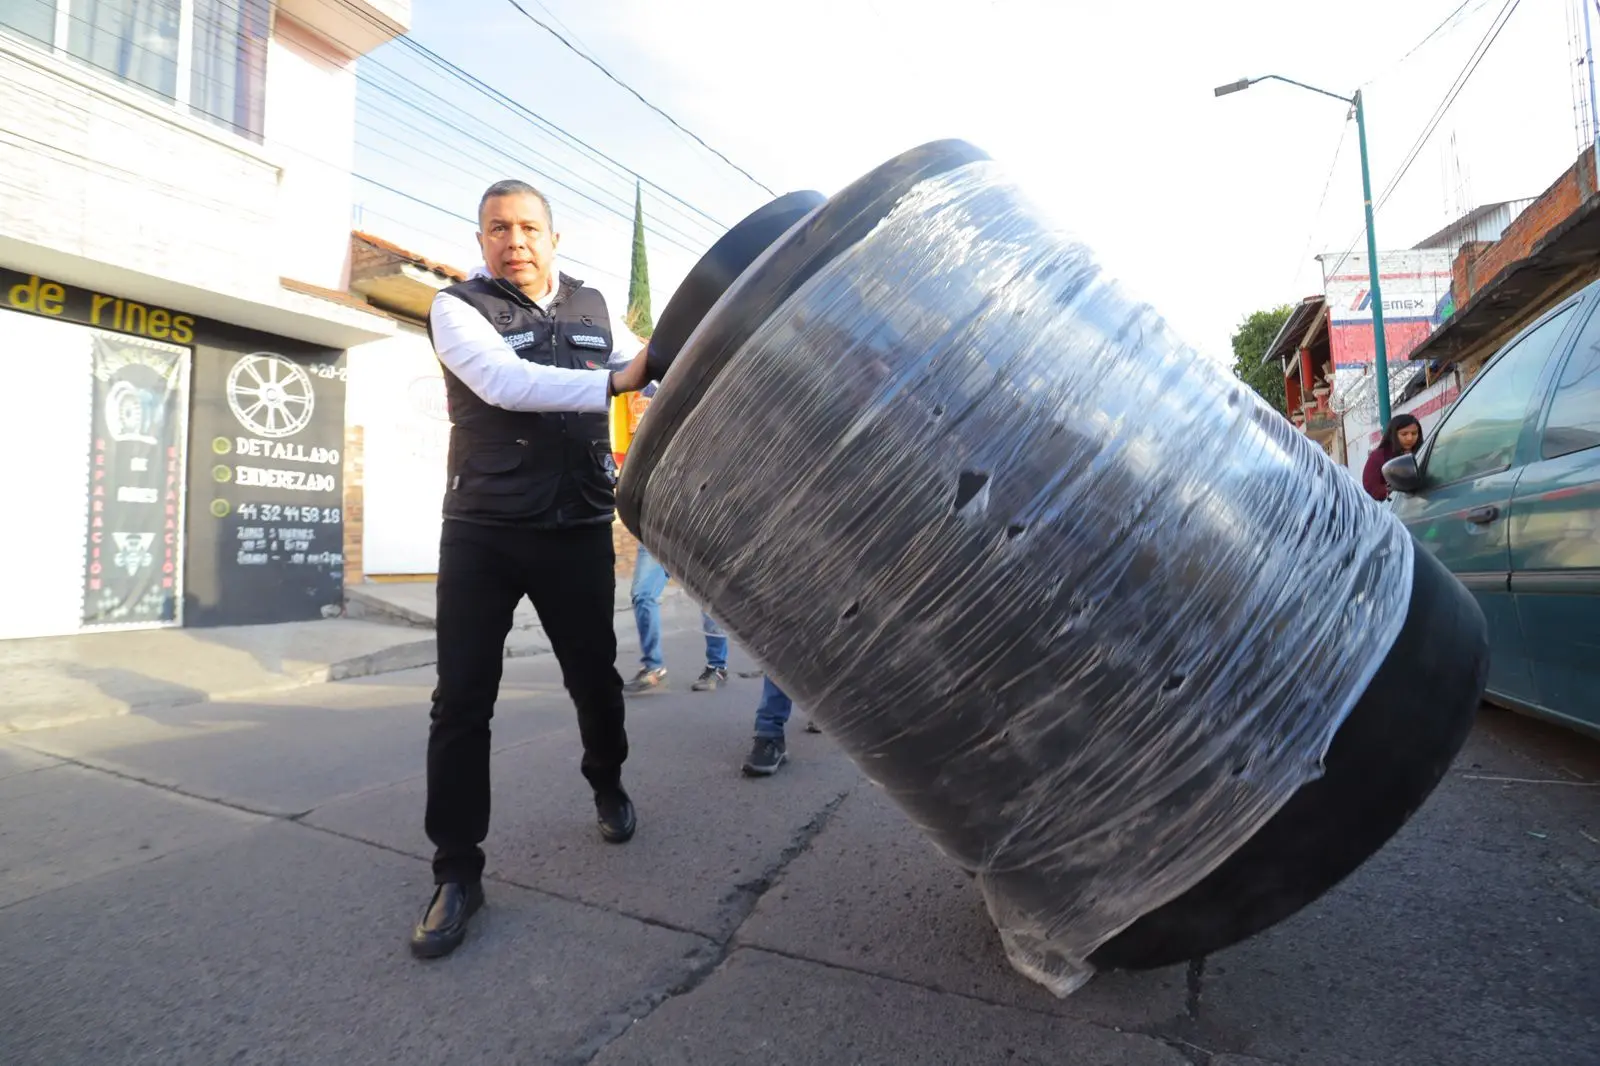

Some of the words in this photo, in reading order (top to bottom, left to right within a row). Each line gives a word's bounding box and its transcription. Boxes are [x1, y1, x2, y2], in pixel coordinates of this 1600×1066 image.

[8, 274, 66, 316] de
[89, 293, 196, 344] rines
[1370, 299, 1425, 311] EMEX
[235, 437, 340, 465] DETALLADO
[260, 504, 281, 521] 32
